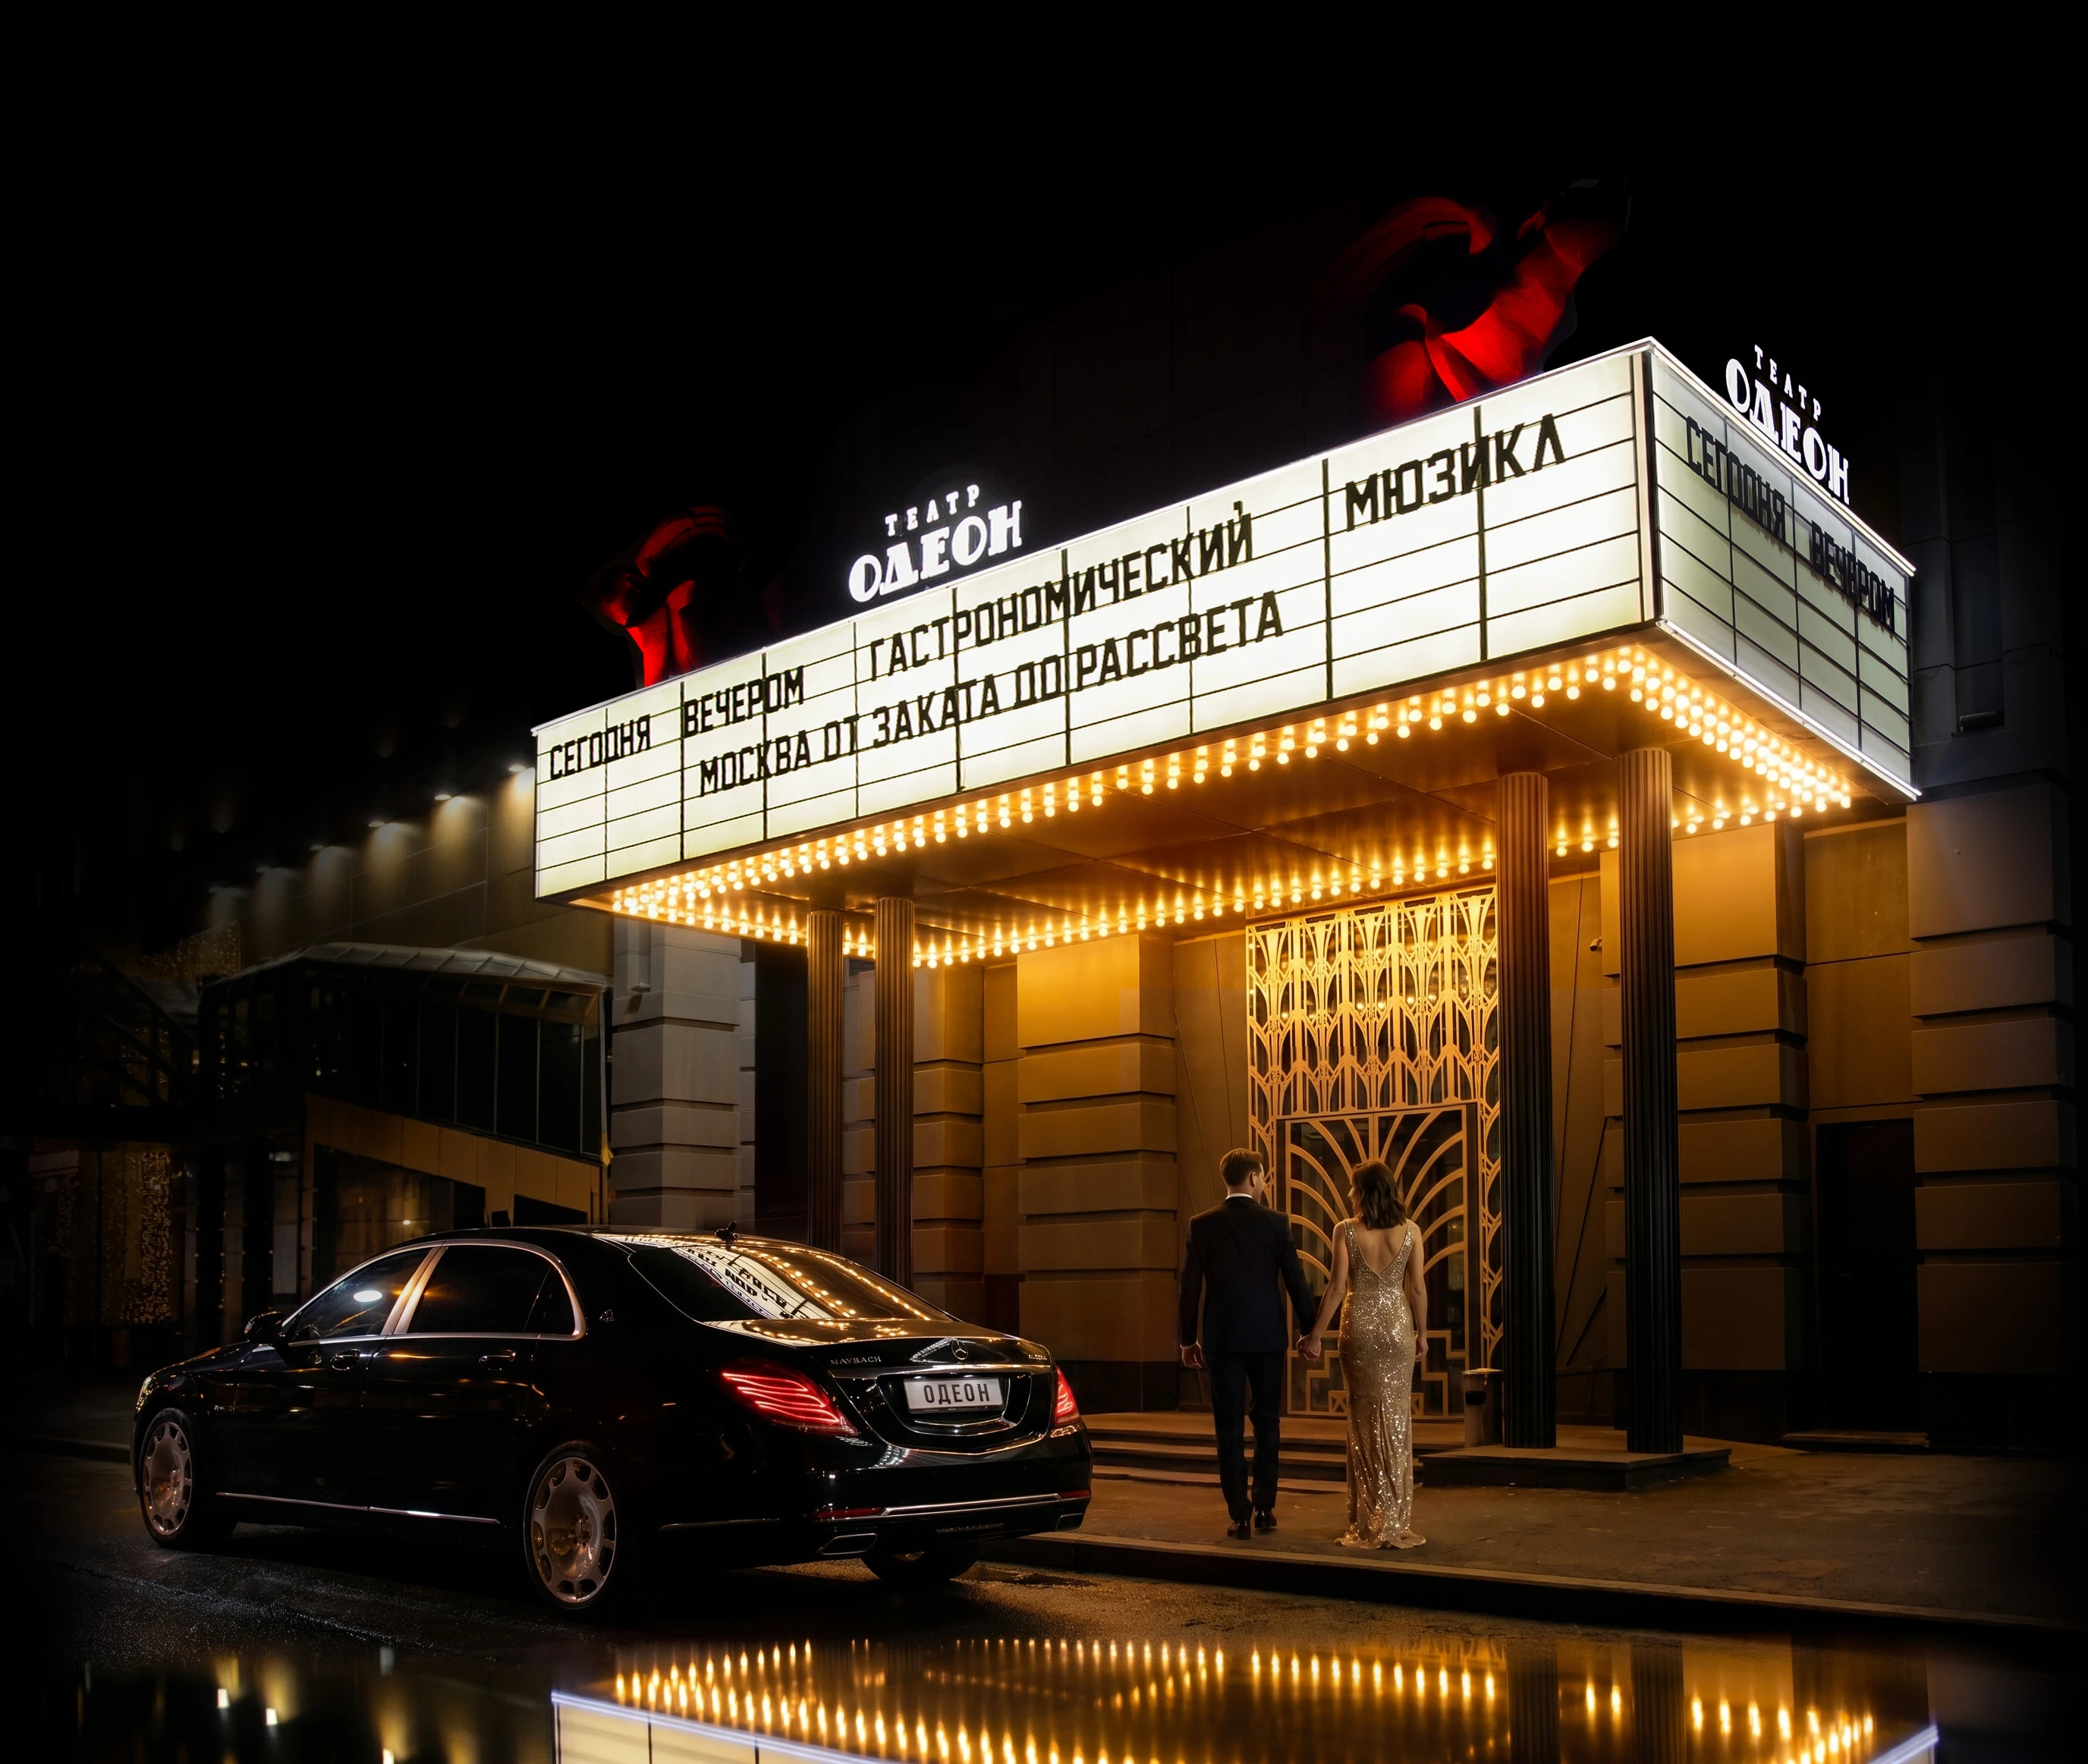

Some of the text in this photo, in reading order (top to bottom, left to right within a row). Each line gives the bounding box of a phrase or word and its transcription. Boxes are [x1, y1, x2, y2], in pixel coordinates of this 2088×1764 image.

[1725, 357, 1849, 505] ОДЕОН
[1754, 344, 1821, 421] ТЕАТР
[885, 484, 980, 536] ТЕАТР
[1685, 415, 1786, 545] СЕГОДНЯ
[549, 413, 1566, 781] СЕГОДНЯ ВЕЧЕРОМ ГАСТРОНОМИЧЕСКИЙ МЮЗИКЛ
[849, 500, 1023, 602] ОДЕОН
[700, 590, 1284, 798] МОСКВА ОТ ЗАКАТА ДО РАССВЕТА
[830, 1356, 882, 1365] MAYBACH
[923, 1383, 990, 1405] ОДЕОН
